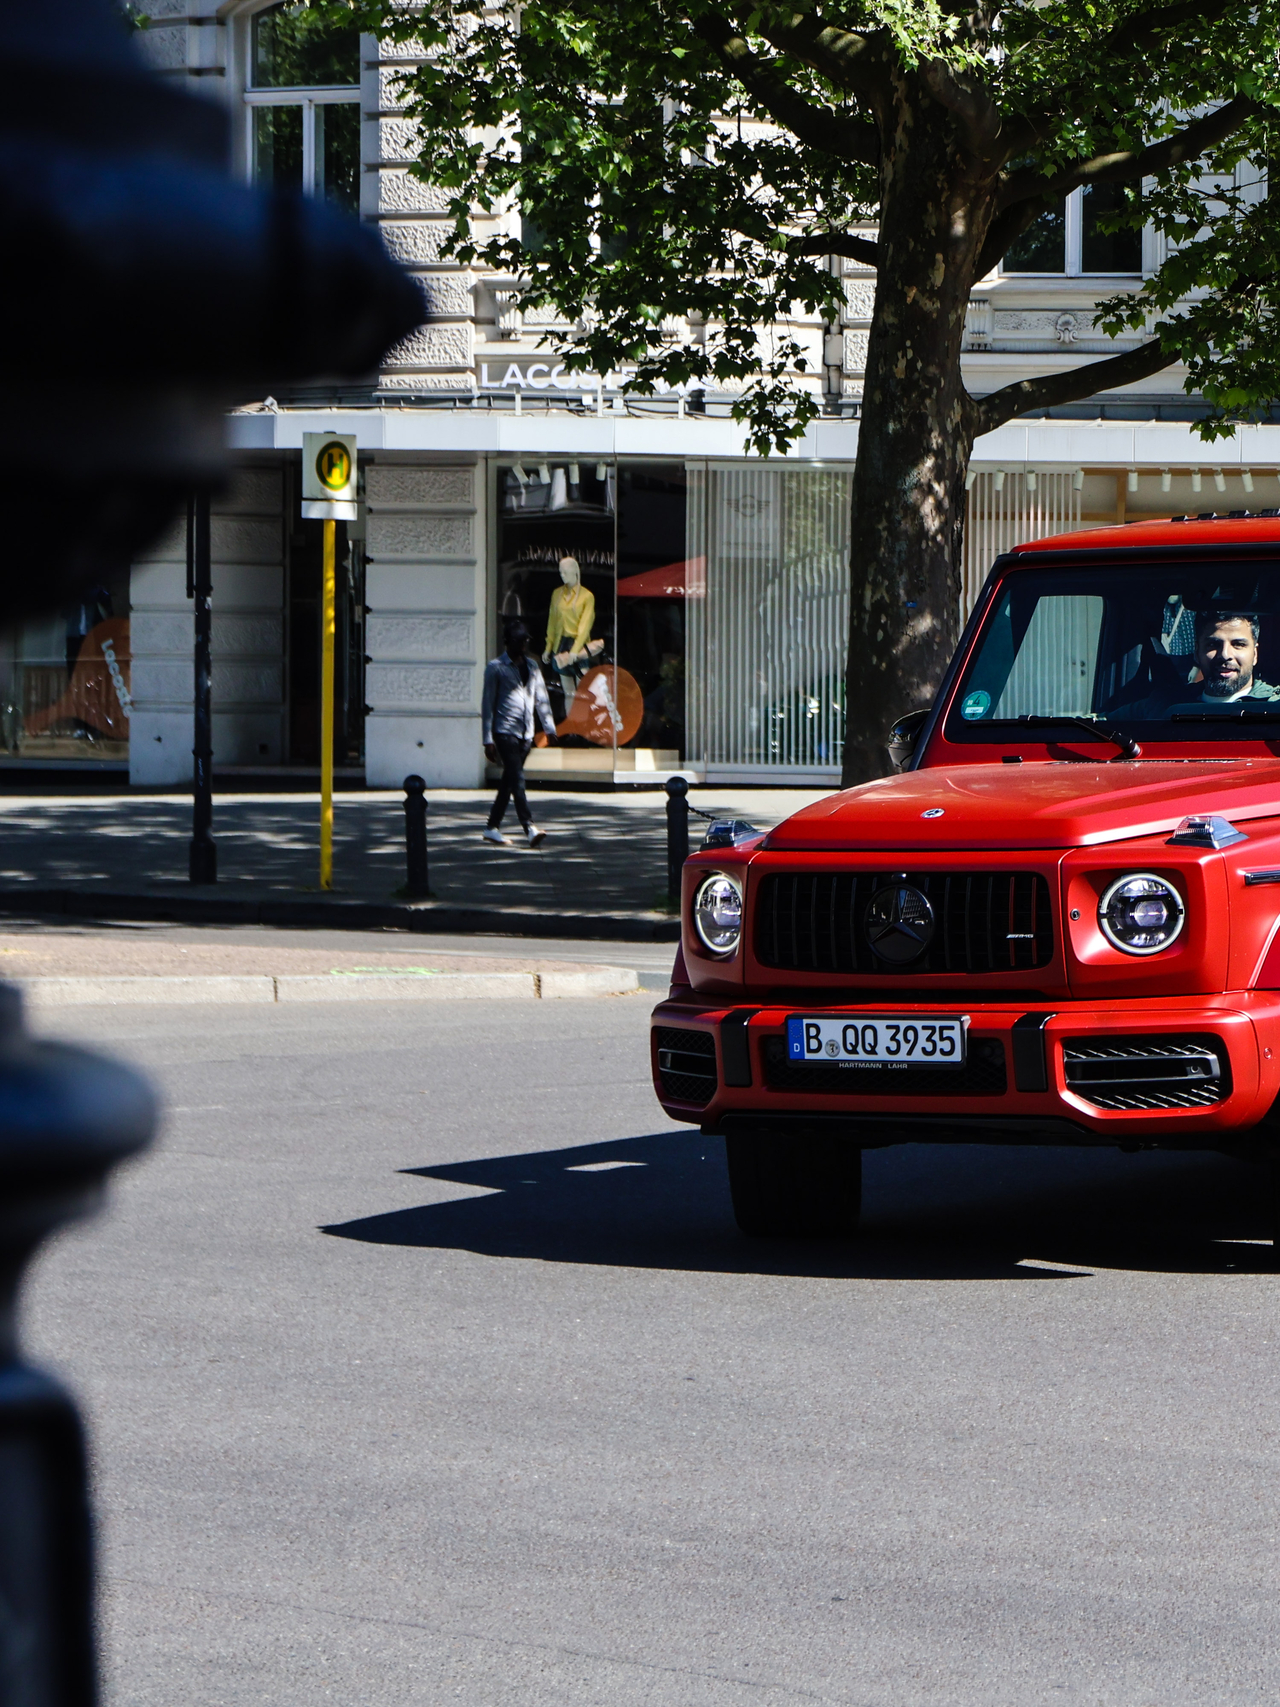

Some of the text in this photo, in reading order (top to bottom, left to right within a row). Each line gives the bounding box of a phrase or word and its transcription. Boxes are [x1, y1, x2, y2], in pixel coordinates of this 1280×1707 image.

[805, 1022, 956, 1057] B QQ 3935
[793, 1042, 801, 1053] D
[839, 1061, 908, 1070] HARTMANN LAHR
